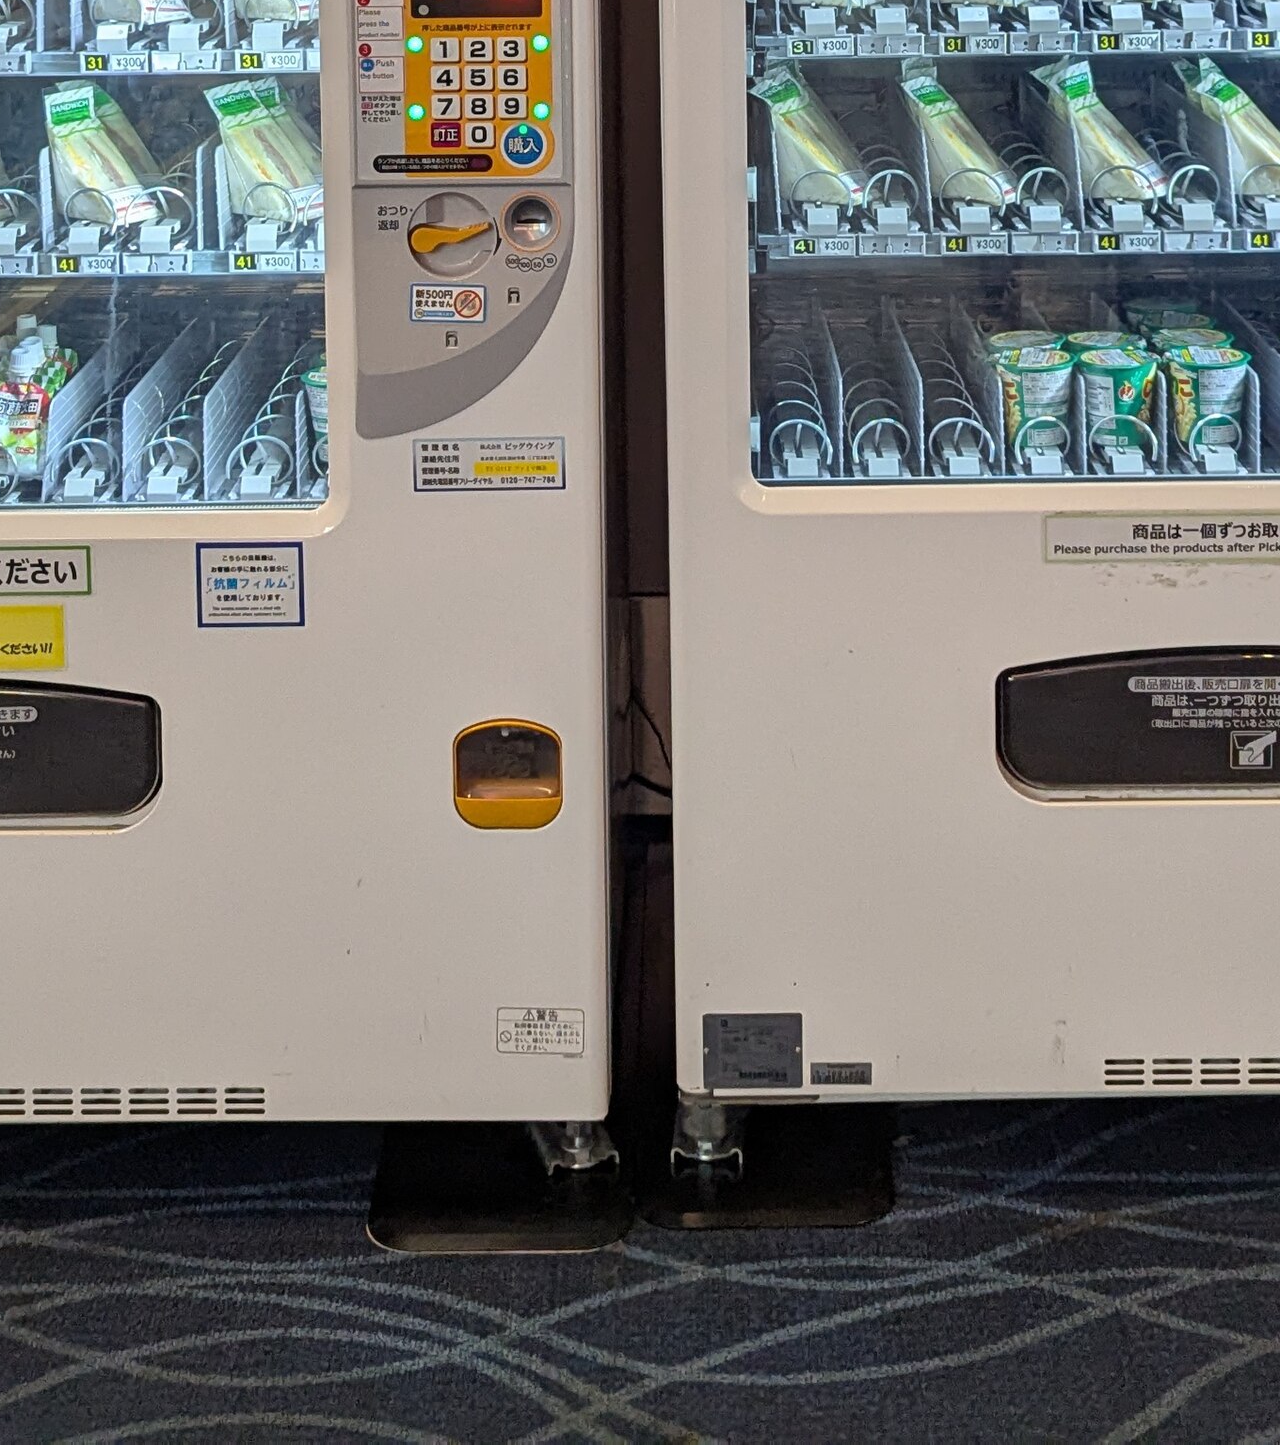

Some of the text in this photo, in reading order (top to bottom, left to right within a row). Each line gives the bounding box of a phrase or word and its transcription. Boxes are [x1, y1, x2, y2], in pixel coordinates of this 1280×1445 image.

[439, 41, 448, 58] 1
[470, 40, 486, 58] 2
[504, 40, 519, 58] 3
[241, 54, 296, 67] 31 ¥300
[375, 59, 395, 67] Push
[436, 69, 453, 86] 4
[470, 69, 486, 86] 5
[503, 69, 519, 86] 6
[51, 99, 89, 113] SANDWICH
[437, 98, 453, 115] 7
[471, 98, 487, 115] 8
[504, 98, 520, 115] 9
[433, 128, 458, 142] 訂正
[471, 126, 487, 143] 0
[508, 136, 540, 154] 購入
[378, 220, 399, 231] 返却
[795, 239, 849, 253] 41 ¥300
[59, 258, 113, 272] 41 ¥300
[415, 289, 453, 300] 新500円
[1054, 544, 1091, 554] Please
[1094, 544, 1147, 556] purchase
[1151, 543, 1170, 553] the
[1174, 543, 1223, 555] products
[1227, 542, 1254, 552] after
